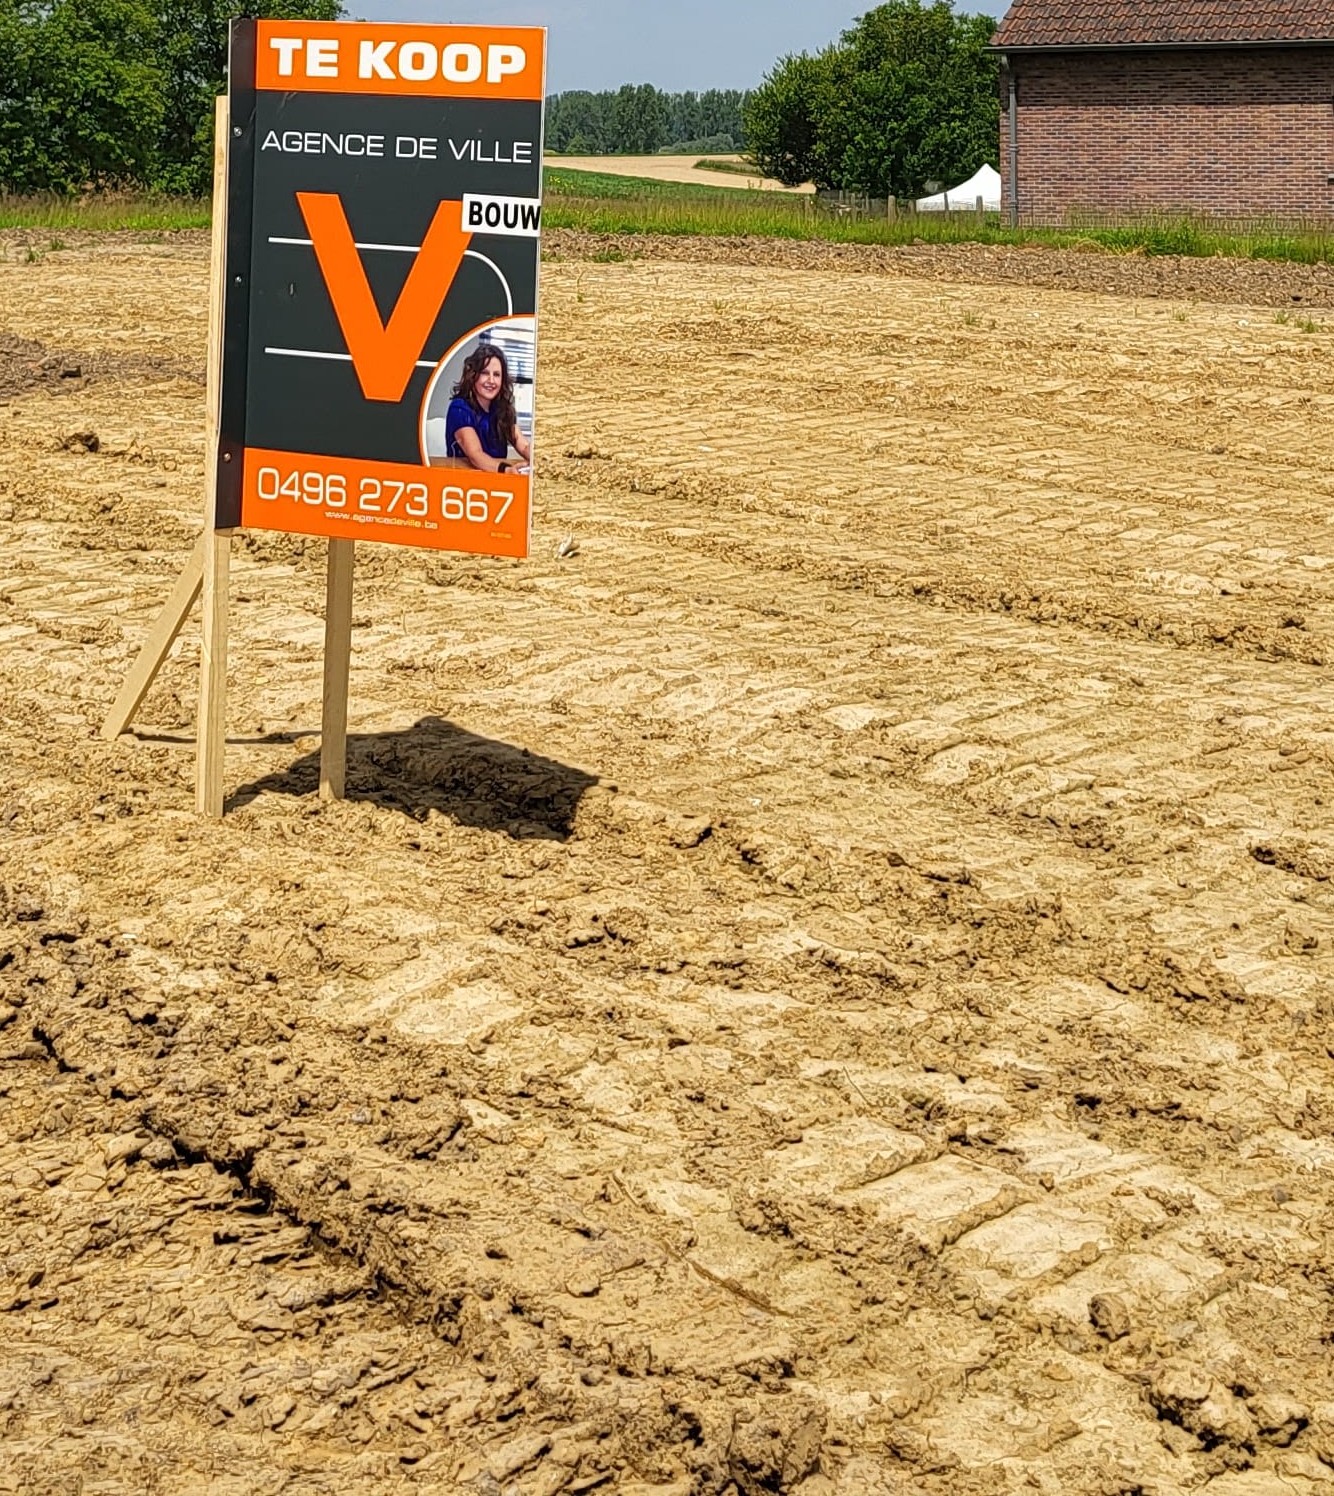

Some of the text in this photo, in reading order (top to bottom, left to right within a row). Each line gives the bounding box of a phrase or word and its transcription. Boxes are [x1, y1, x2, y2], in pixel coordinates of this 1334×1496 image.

[269, 37, 527, 84] TE KOOP
[260, 130, 533, 164] AGENCE DE VILLE
[468, 200, 542, 231] BOUW
[296, 191, 474, 403] V
[257, 467, 514, 524] 0496 273 667
